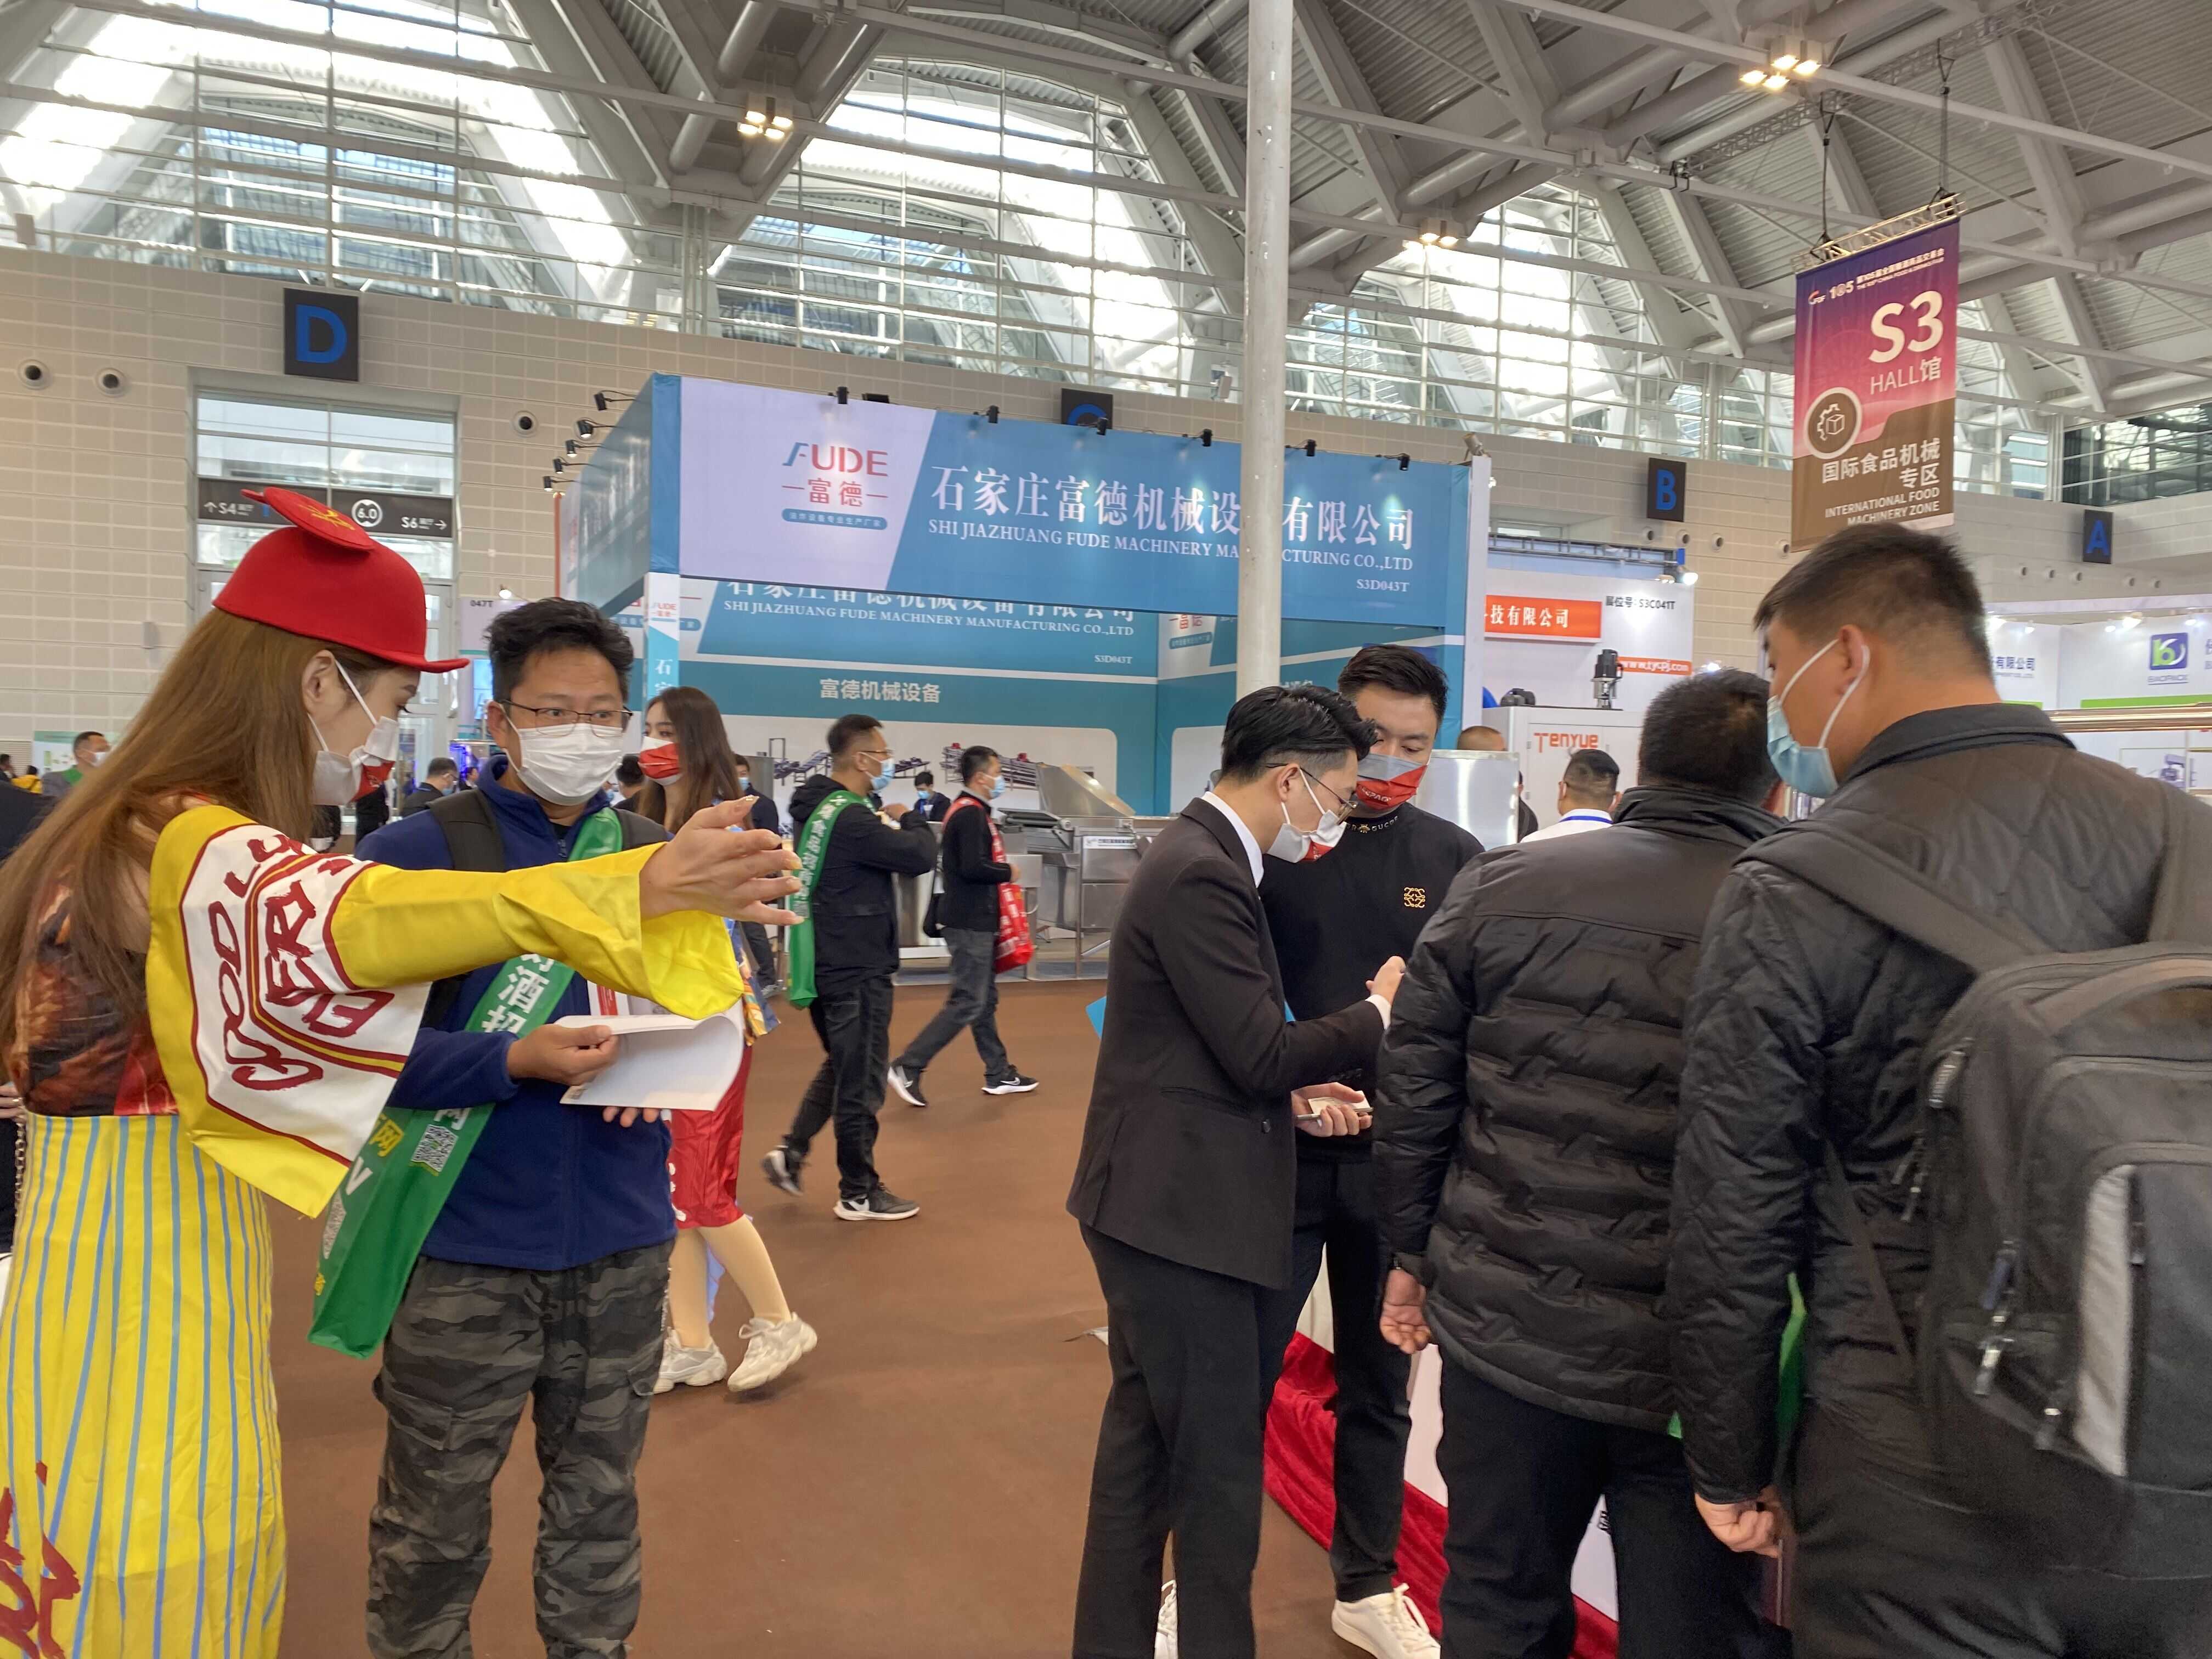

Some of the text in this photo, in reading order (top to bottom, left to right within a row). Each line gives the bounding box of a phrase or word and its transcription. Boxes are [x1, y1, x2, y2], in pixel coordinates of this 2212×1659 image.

[295, 304, 347, 363] D
[1869, 290, 1943, 363] S3
[782, 442, 888, 477] FUDE
[1822, 437, 1940, 484] 国际食品机械
[1899, 462, 1940, 488] 专区
[808, 478, 862, 507] 富德
[1656, 469, 1677, 510] B
[1825, 487, 1940, 518] INTERNATIONAL FOOD
[218, 503, 236, 515] S4
[401, 517, 418, 528] S6
[930, 465, 1413, 550] 石家庄富德机械设有限公司
[1909, 500, 1940, 516] ZONE
[928, 519, 958, 535] SHI
[960, 521, 1063, 545] JIAZHUANG
[1066, 532, 1110, 549] FUDE
[1114, 535, 1214, 557] MACHINERY
[1215, 544, 1351, 566] MACTURING
[2086, 519, 2111, 556] A
[1356, 579, 1410, 592] S3D043T
[724, 600, 749, 611] SHI
[751, 602, 837, 618] JIAZHUANG
[839, 608, 877, 620] FUDE
[879, 612, 963, 626] MACHINERY
[966, 617, 1080, 633] MANUFACTURING
[1485, 604, 1569, 628] 技有限公司
[1993, 656, 2035, 671] 有限公司
[819, 678, 941, 703] 富德机械设备
